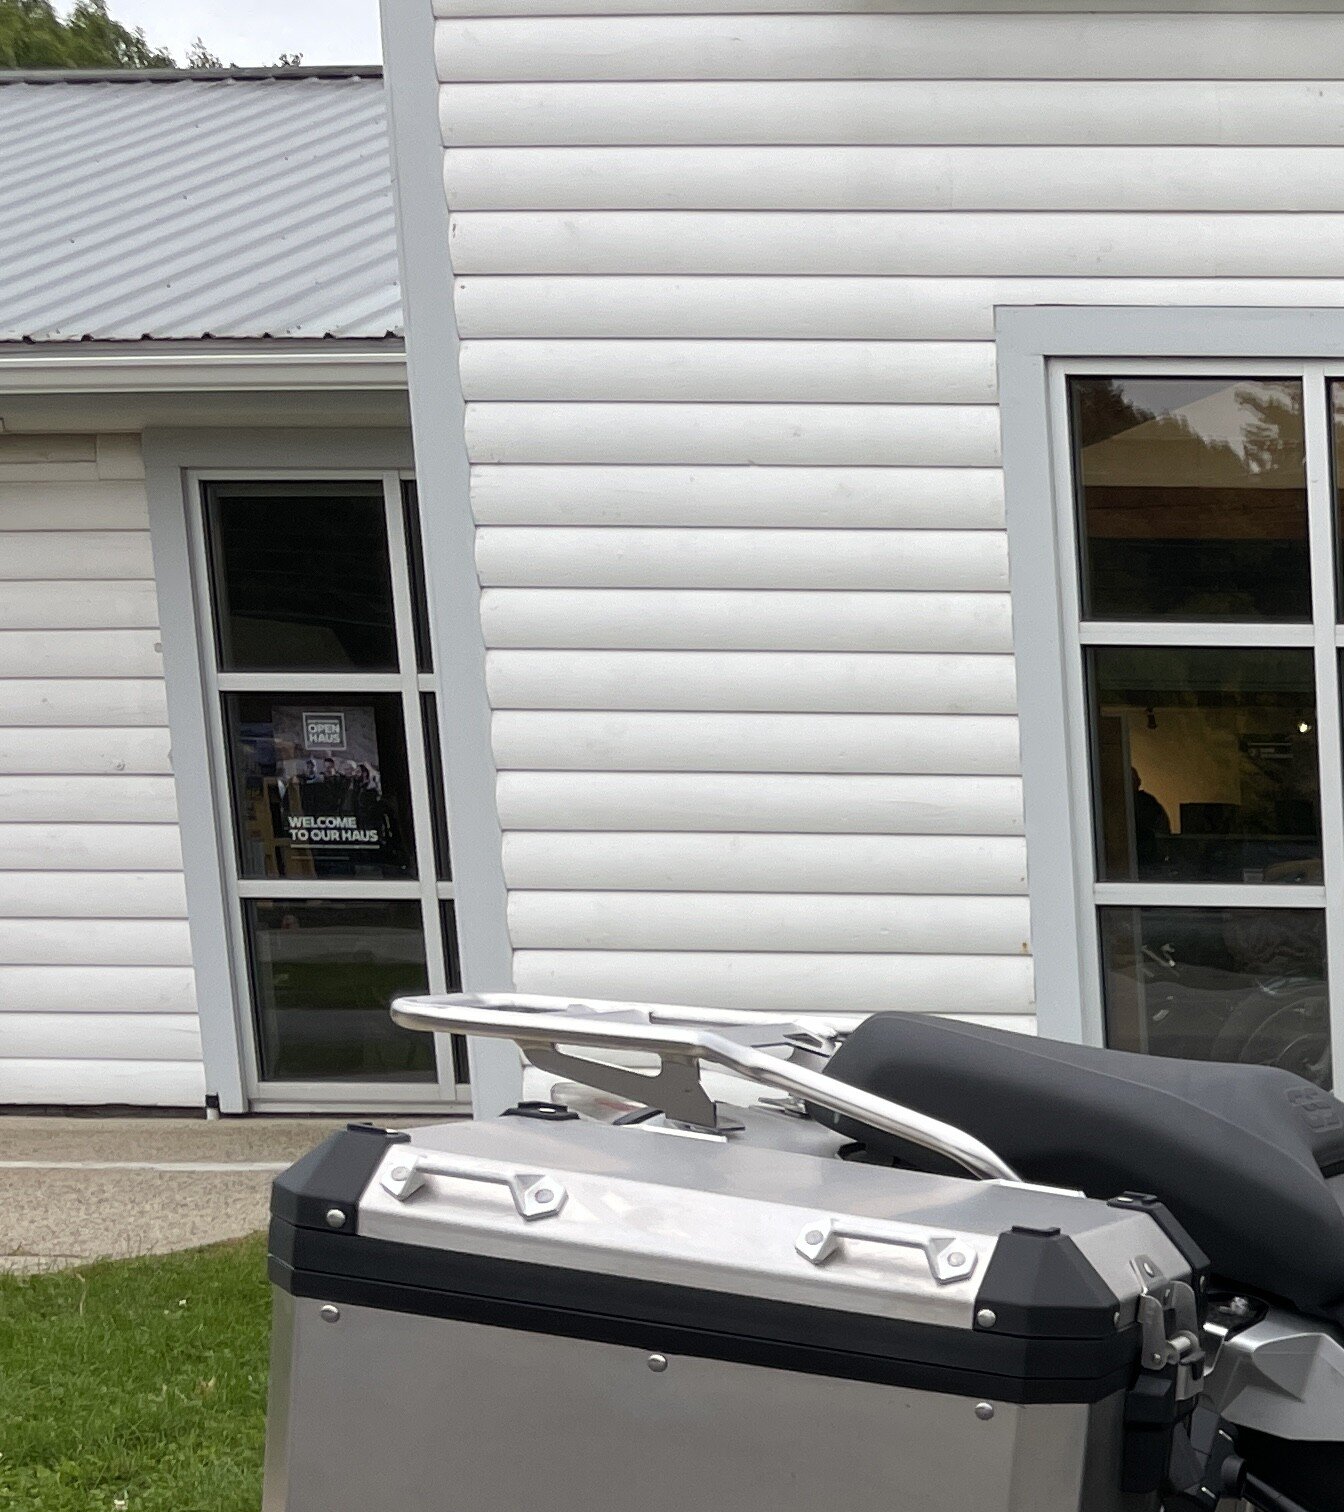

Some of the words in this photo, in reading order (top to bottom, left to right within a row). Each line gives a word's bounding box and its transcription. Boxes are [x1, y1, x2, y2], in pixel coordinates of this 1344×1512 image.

[308, 723, 340, 733] OPEN
[309, 733, 340, 743] HAUS
[289, 816, 357, 828] WELCOME
[290, 829, 309, 841] TO
[311, 830, 340, 841] OUR
[342, 830, 378, 842] HAUS
